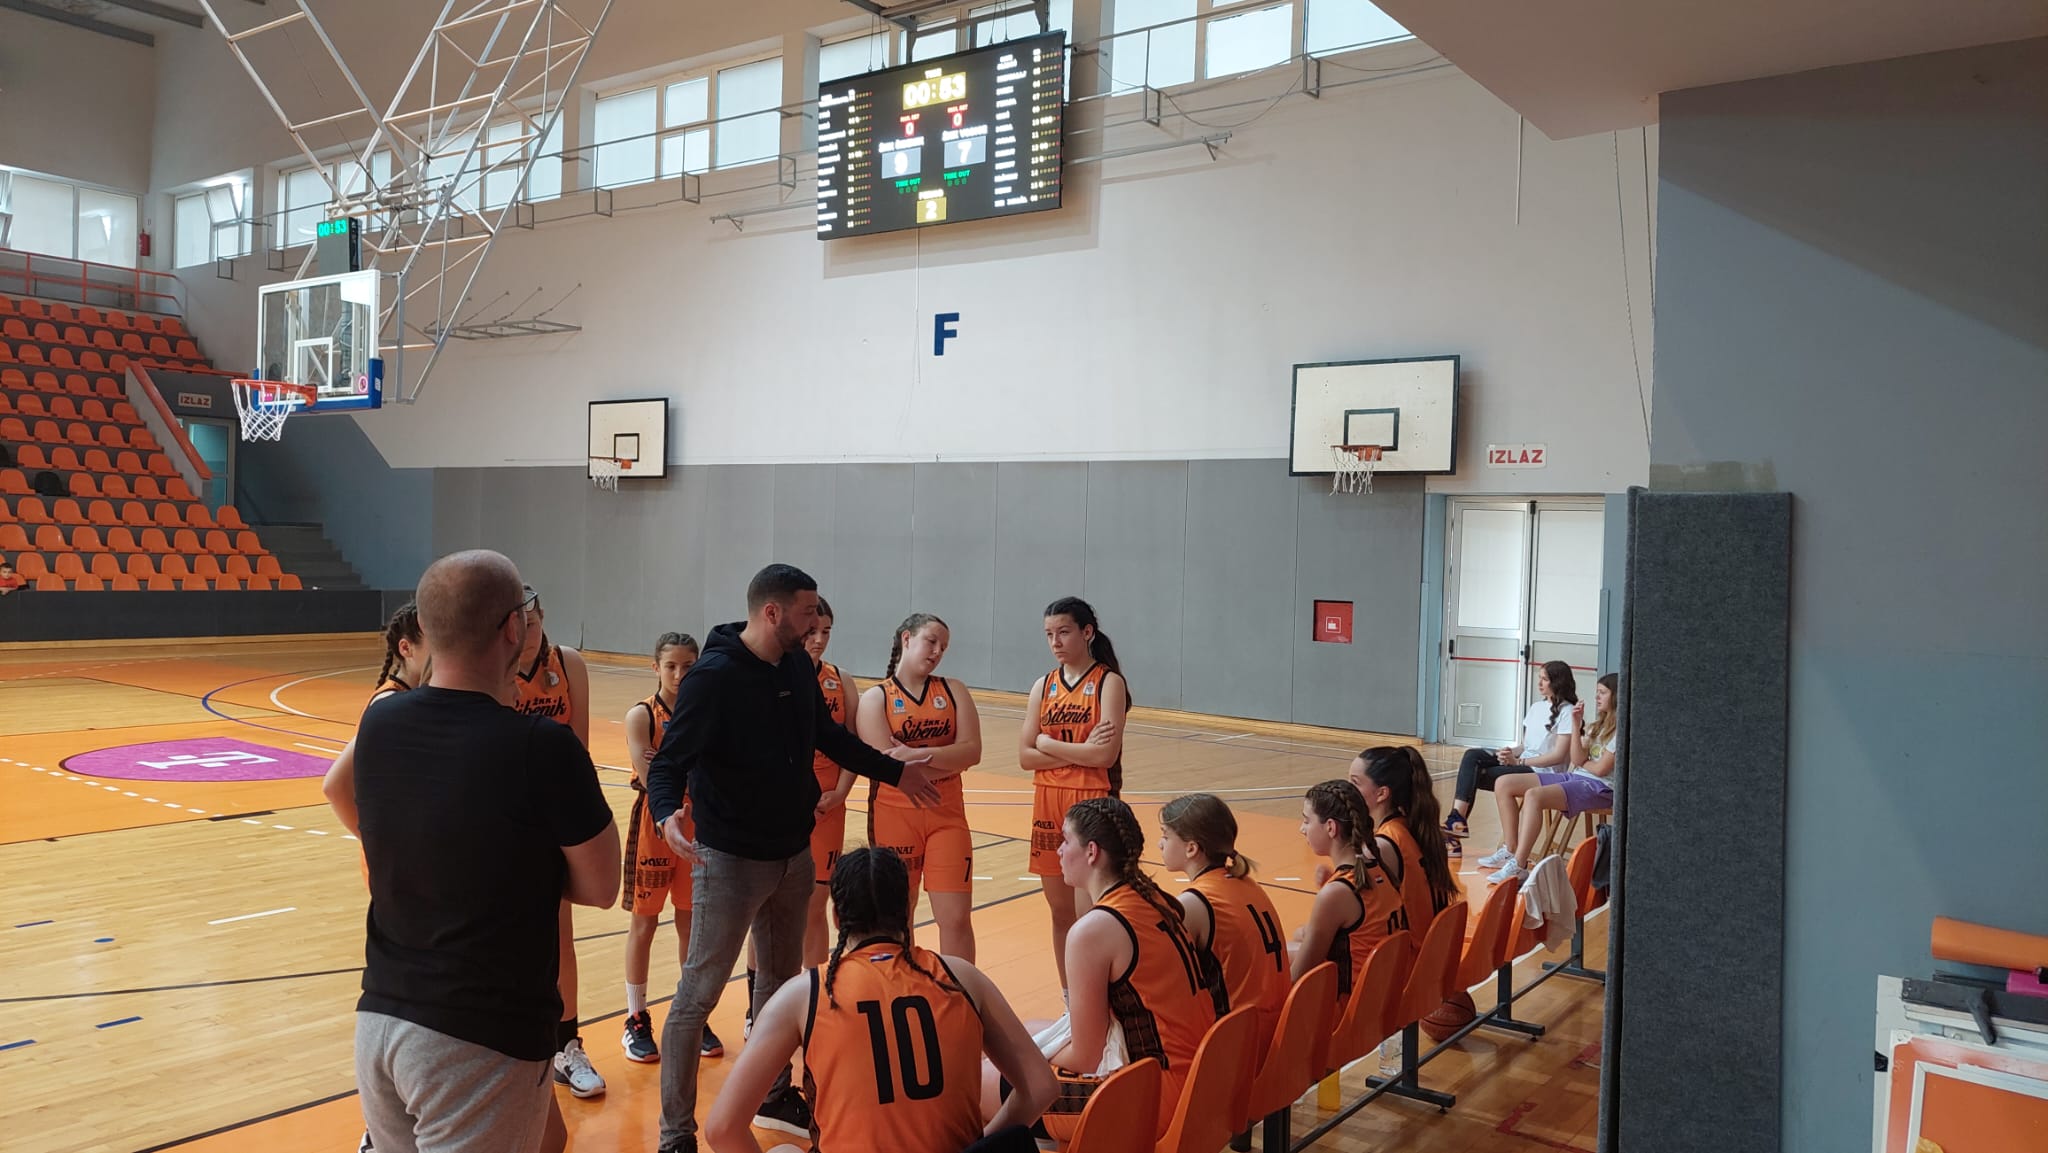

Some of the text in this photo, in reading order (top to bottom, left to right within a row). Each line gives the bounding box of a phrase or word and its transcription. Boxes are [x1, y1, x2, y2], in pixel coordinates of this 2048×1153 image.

[957, 140, 972, 163] 7
[925, 200, 938, 220] 2
[934, 312, 960, 356] F
[180, 395, 211, 406] IZLAZ
[1488, 448, 1544, 464] IZLAZ
[964, 856, 972, 883] 7
[1246, 903, 1283, 973] 4
[856, 995, 945, 1105] 10
